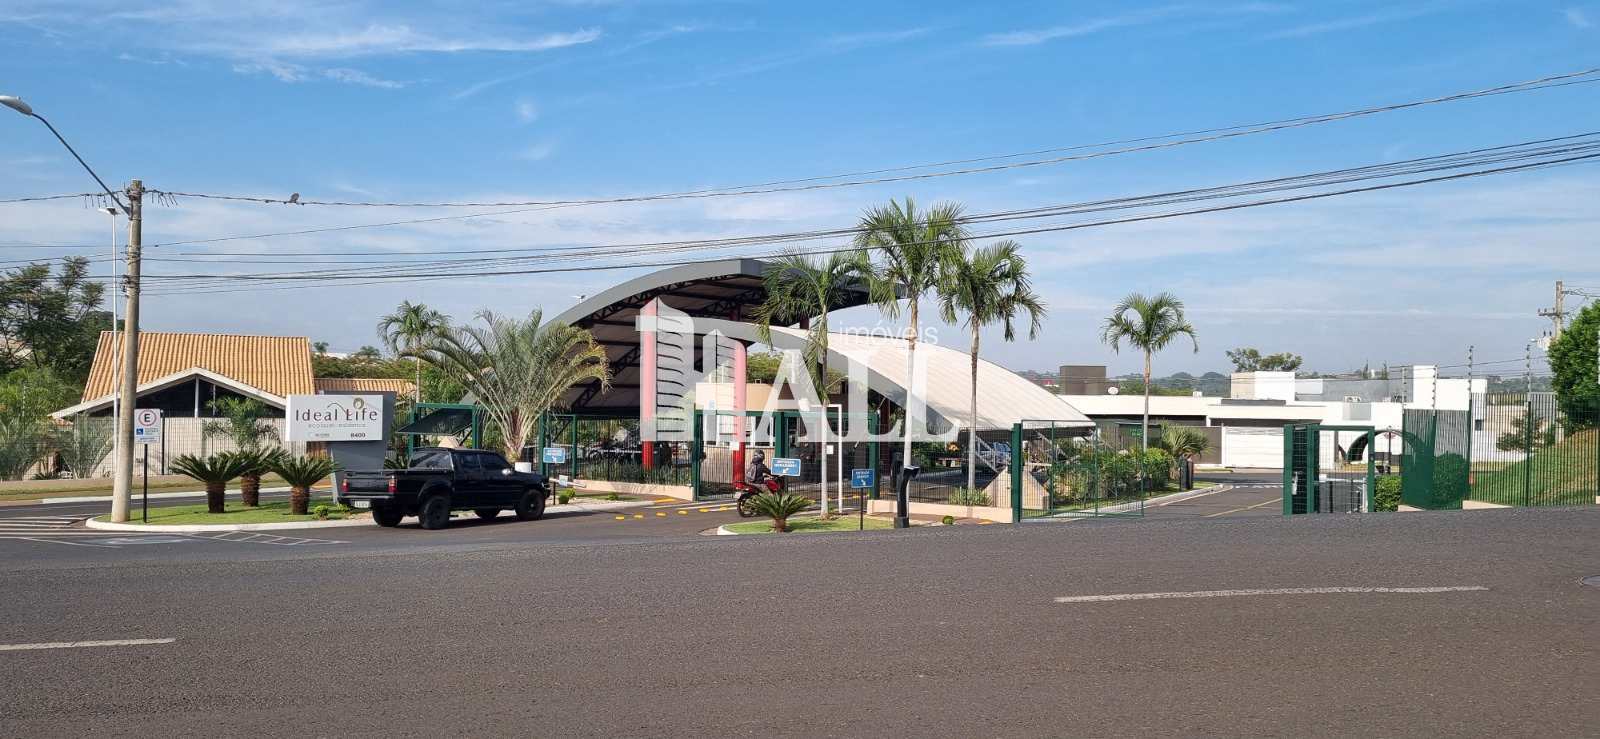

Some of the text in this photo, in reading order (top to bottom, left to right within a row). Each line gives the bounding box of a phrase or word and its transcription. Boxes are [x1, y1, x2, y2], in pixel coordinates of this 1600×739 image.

[144, 413, 151, 423] E
[295, 407, 378, 421] Ideal Life
